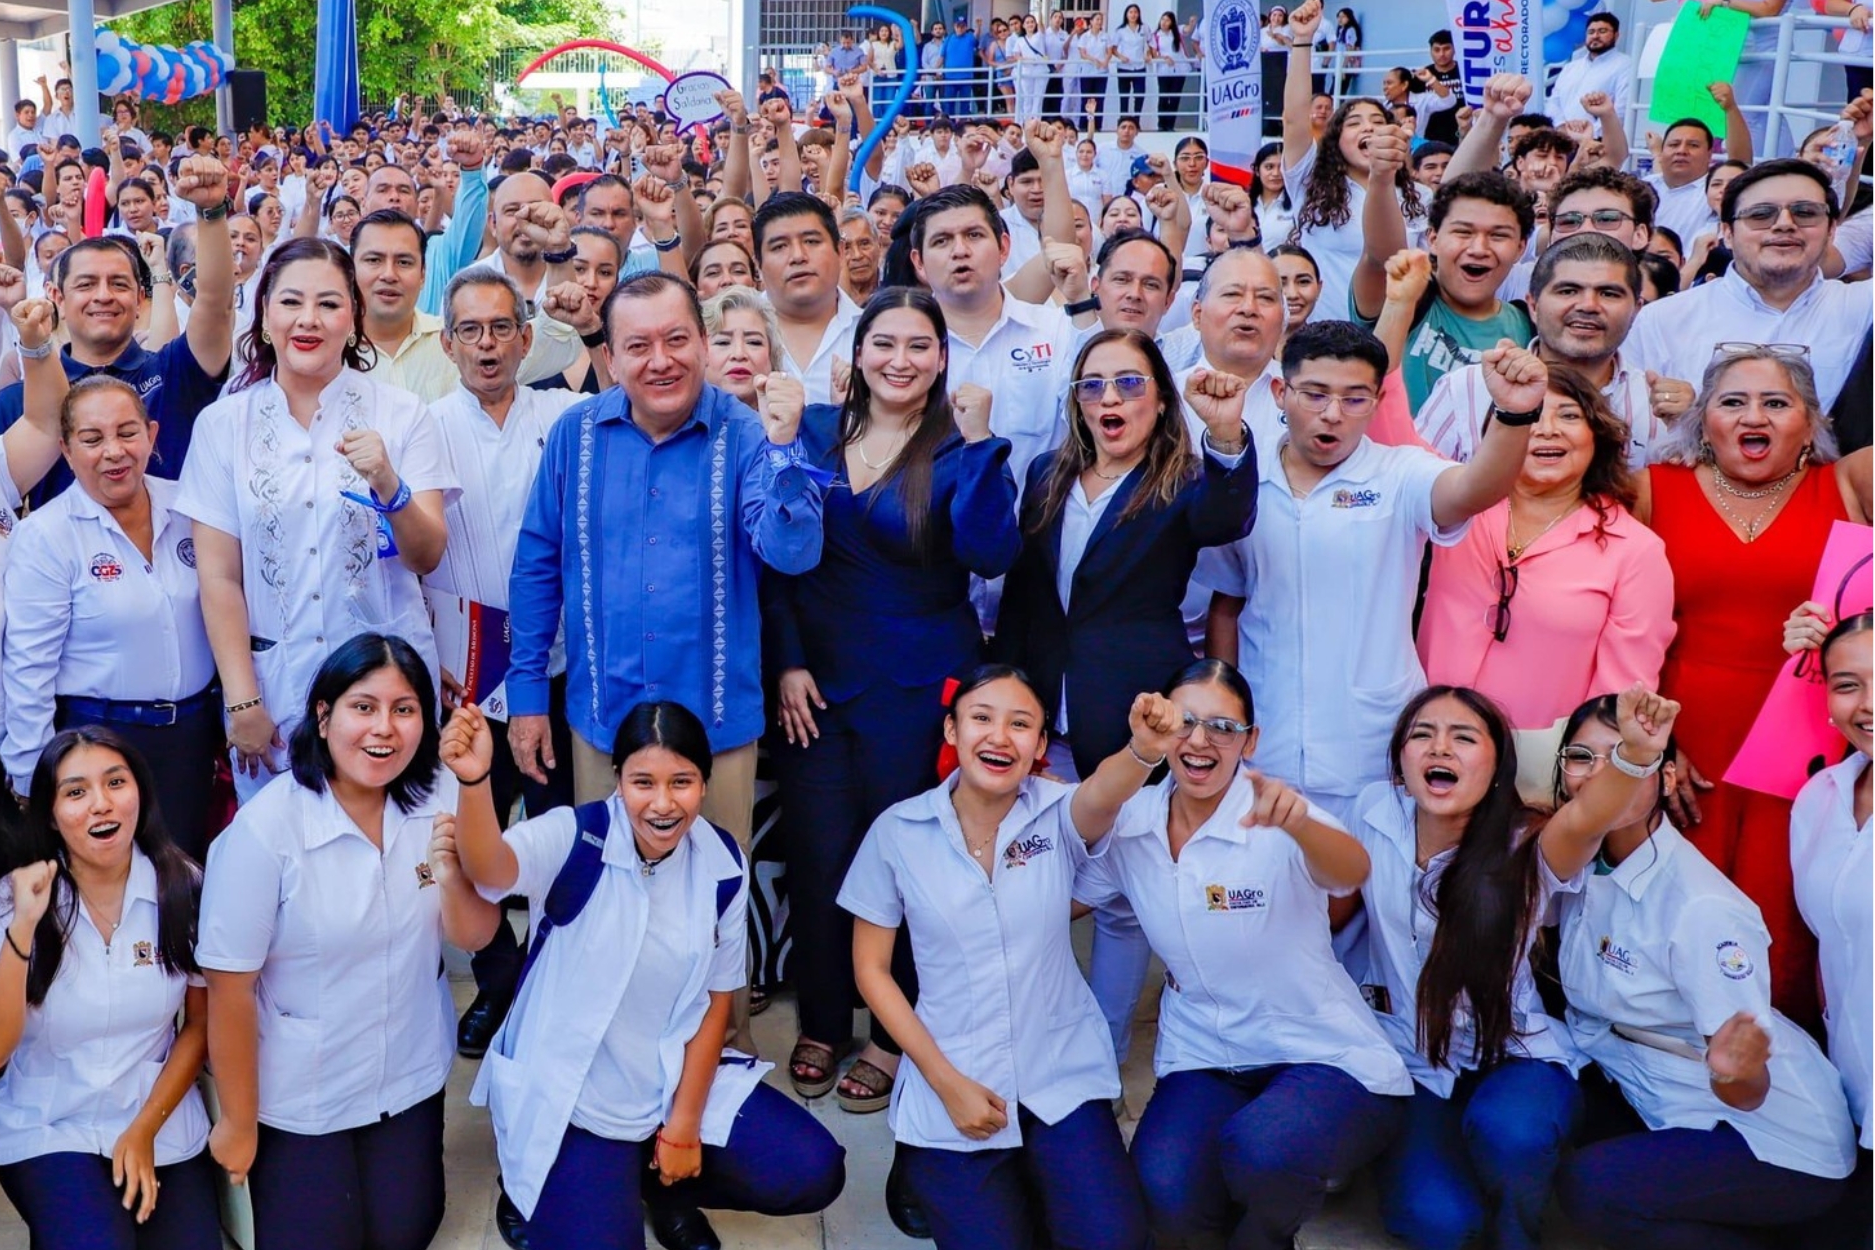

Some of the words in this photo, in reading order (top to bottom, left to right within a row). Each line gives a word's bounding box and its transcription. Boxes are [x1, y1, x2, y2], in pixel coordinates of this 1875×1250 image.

[1212, 80, 1260, 106] UAGro
[1011, 343, 1052, 362] CyTI
[1228, 888, 1264, 900] UAGro
